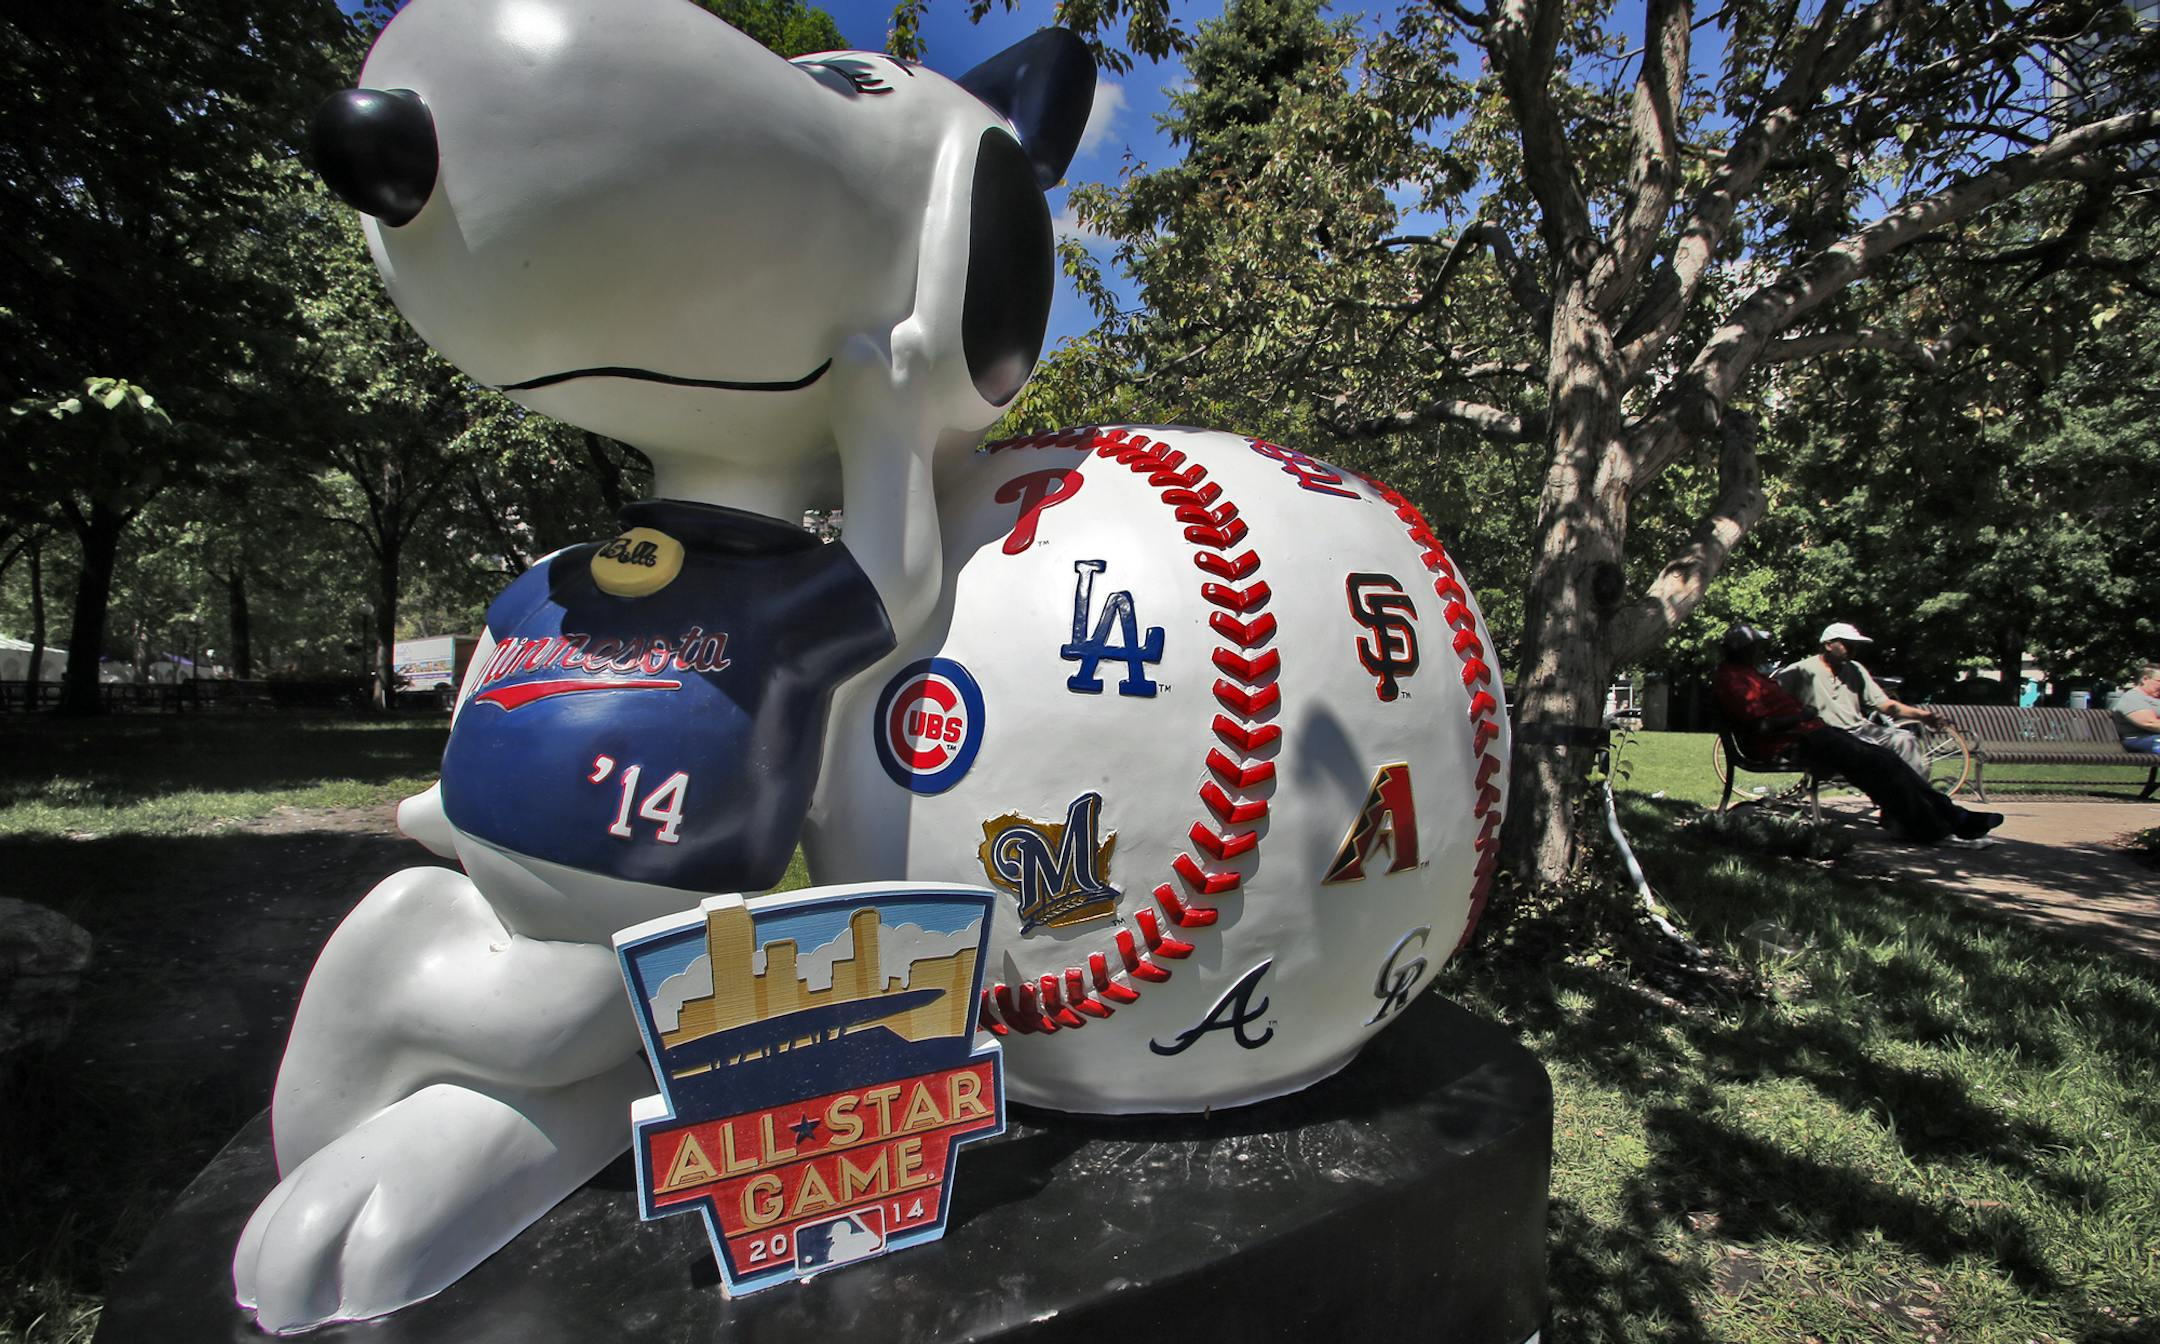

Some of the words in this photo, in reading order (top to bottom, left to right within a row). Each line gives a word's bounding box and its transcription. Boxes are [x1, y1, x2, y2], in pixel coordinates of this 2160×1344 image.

[994, 467, 1084, 555] P
[466, 626, 731, 698] Minnesota
[1060, 559, 1165, 697] LA
[1346, 572, 1420, 702] SF
[1158, 684, 1172, 693] TM
[1321, 761, 1420, 885] A
[1150, 958, 1274, 1056] A
[665, 1114, 798, 1189] ALL
[824, 1070, 991, 1147] STAR
[749, 1233, 788, 1263] 20
[893, 1198, 924, 1224] 14
